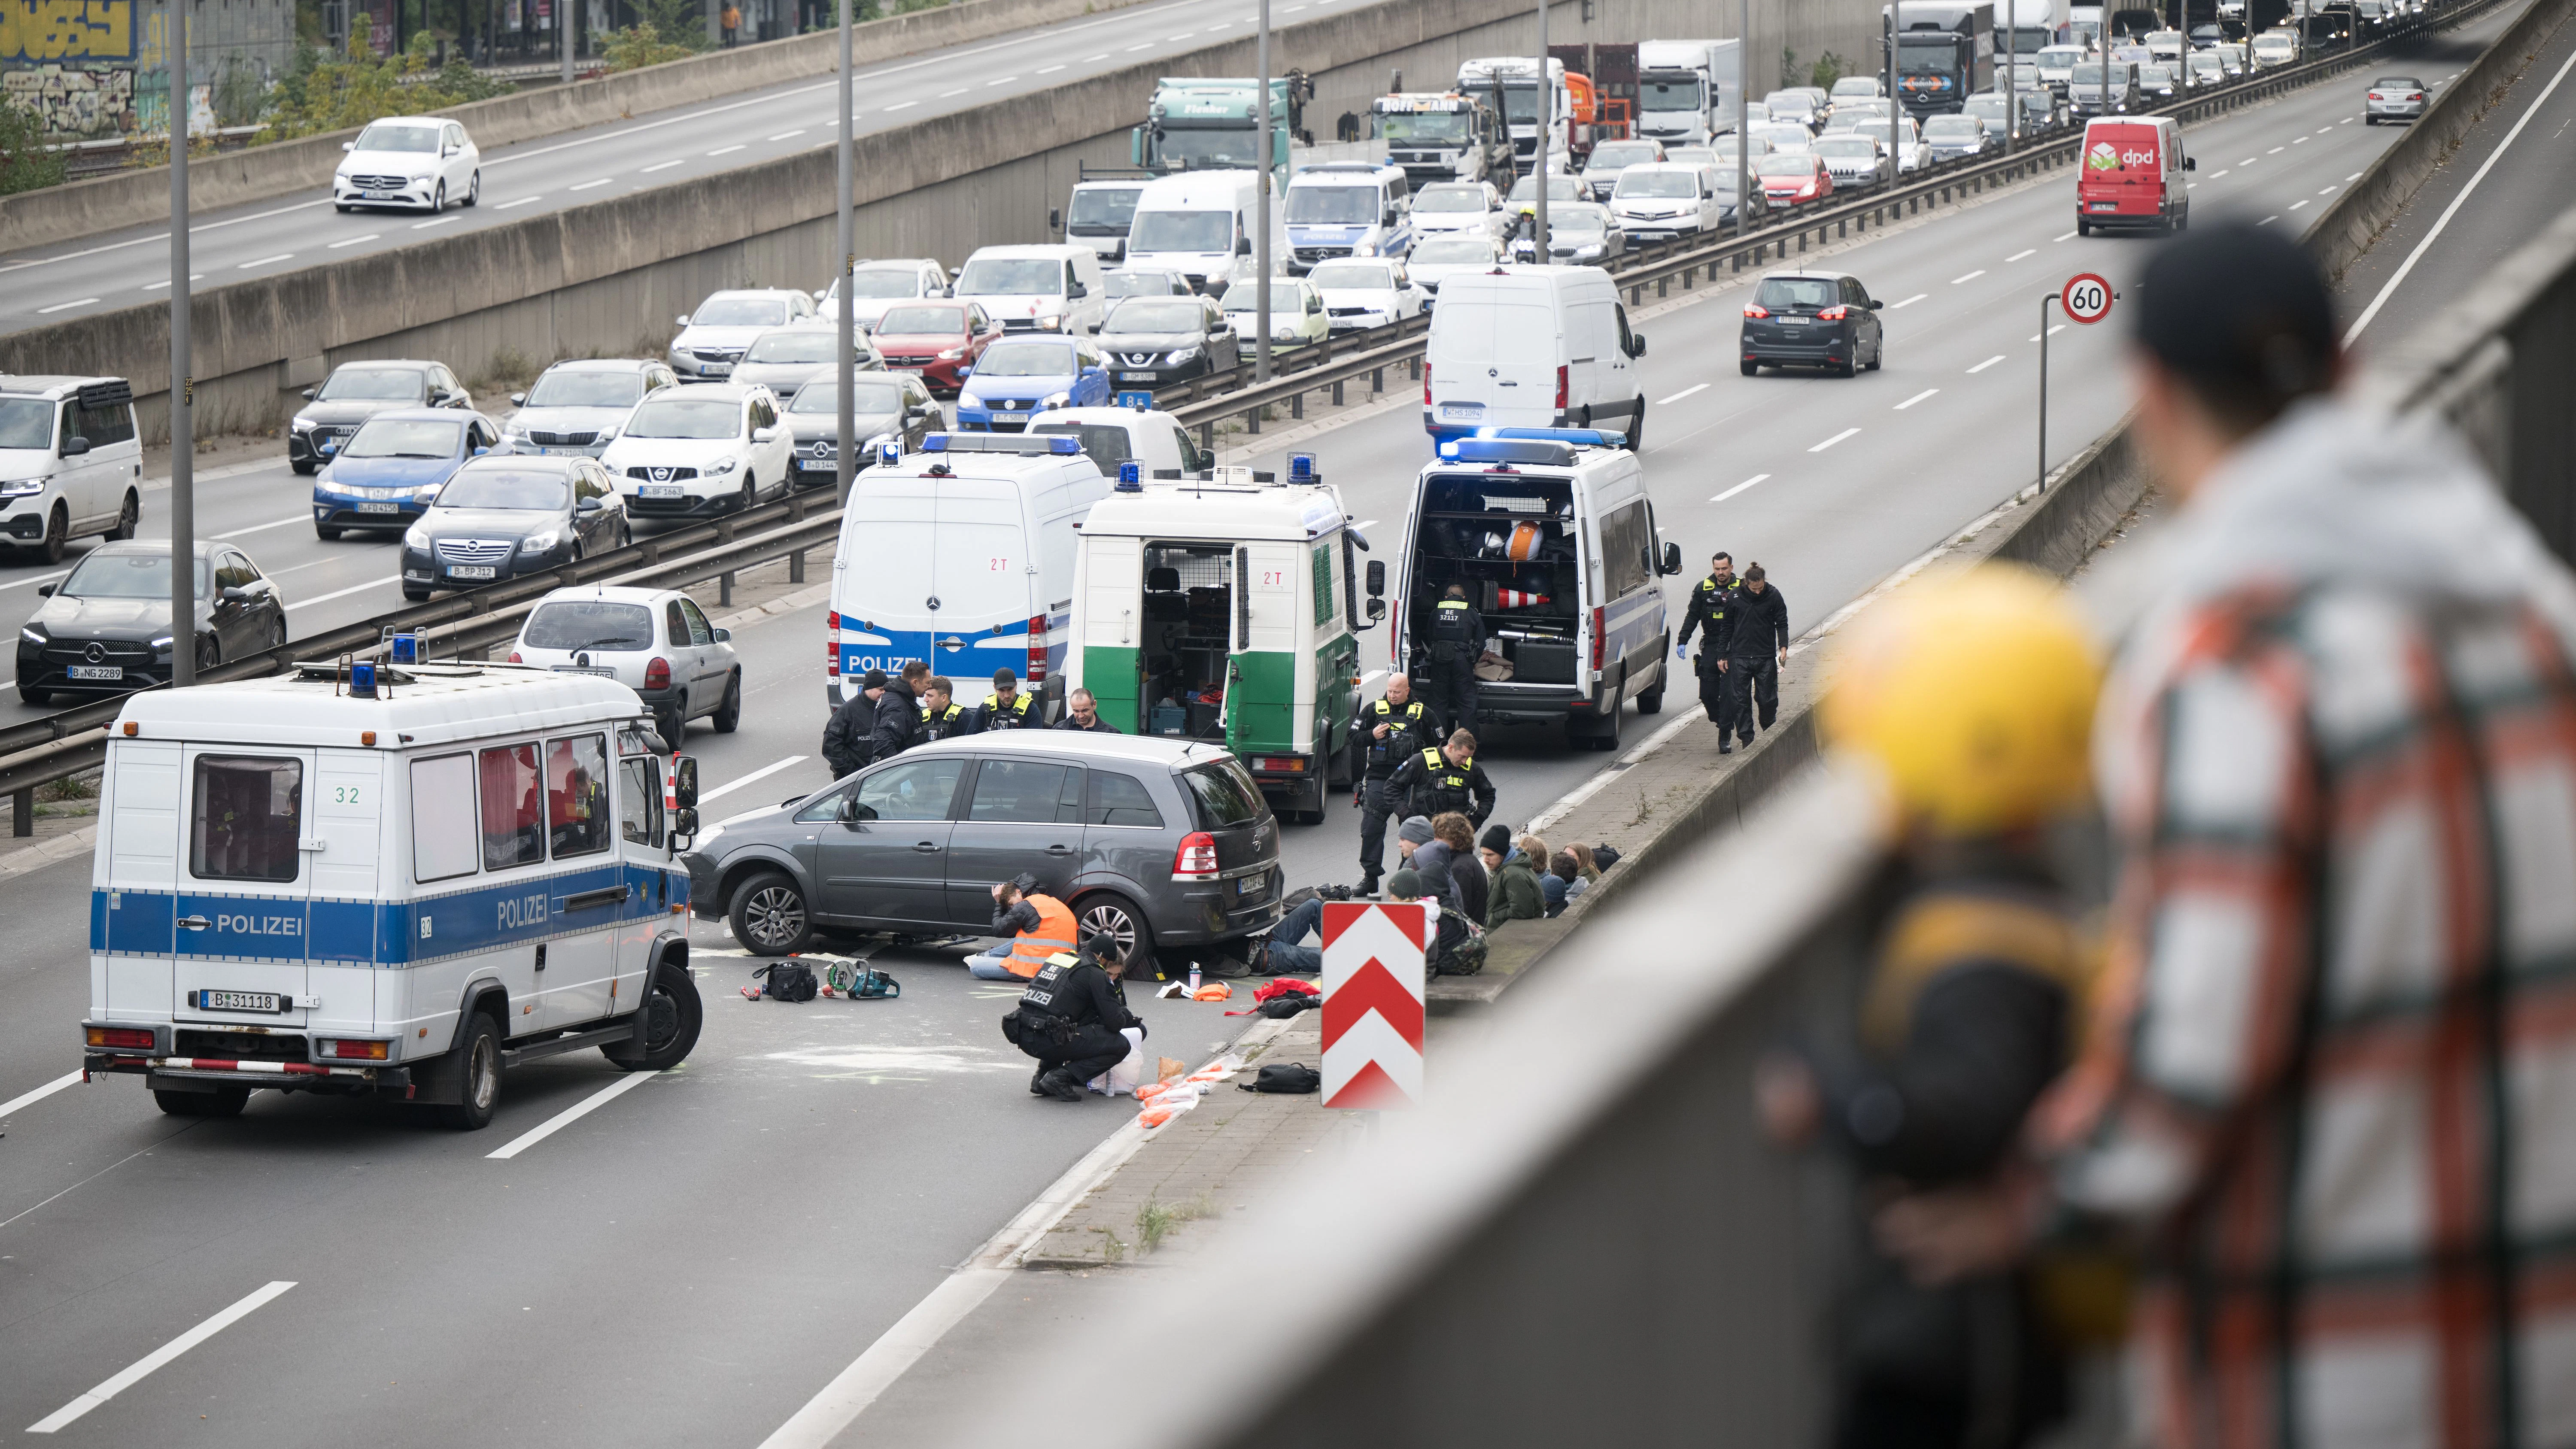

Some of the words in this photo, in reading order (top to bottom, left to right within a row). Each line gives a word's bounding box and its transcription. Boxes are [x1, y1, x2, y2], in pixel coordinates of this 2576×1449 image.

[2122, 148, 2154, 167] dpd
[2073, 287, 2101, 310] 60
[664, 488, 681, 496] 1663
[849, 656, 922, 672] POLIZ
[1316, 647, 1336, 695] POLIZEI
[73, 668, 79, 677] B
[83, 668, 96, 677] NG
[98, 668, 121, 679] 2289
[1241, 877, 1250, 892] MOL
[1252, 876, 1257, 888] AF
[498, 893, 547, 931] POLIZEI
[217, 914, 302, 936] POLIZEI
[1038, 970, 1058, 981] 32115
[1047, 965, 1059, 973] BE
[216, 993, 223, 1006] B
[232, 995, 272, 1009] 31118
